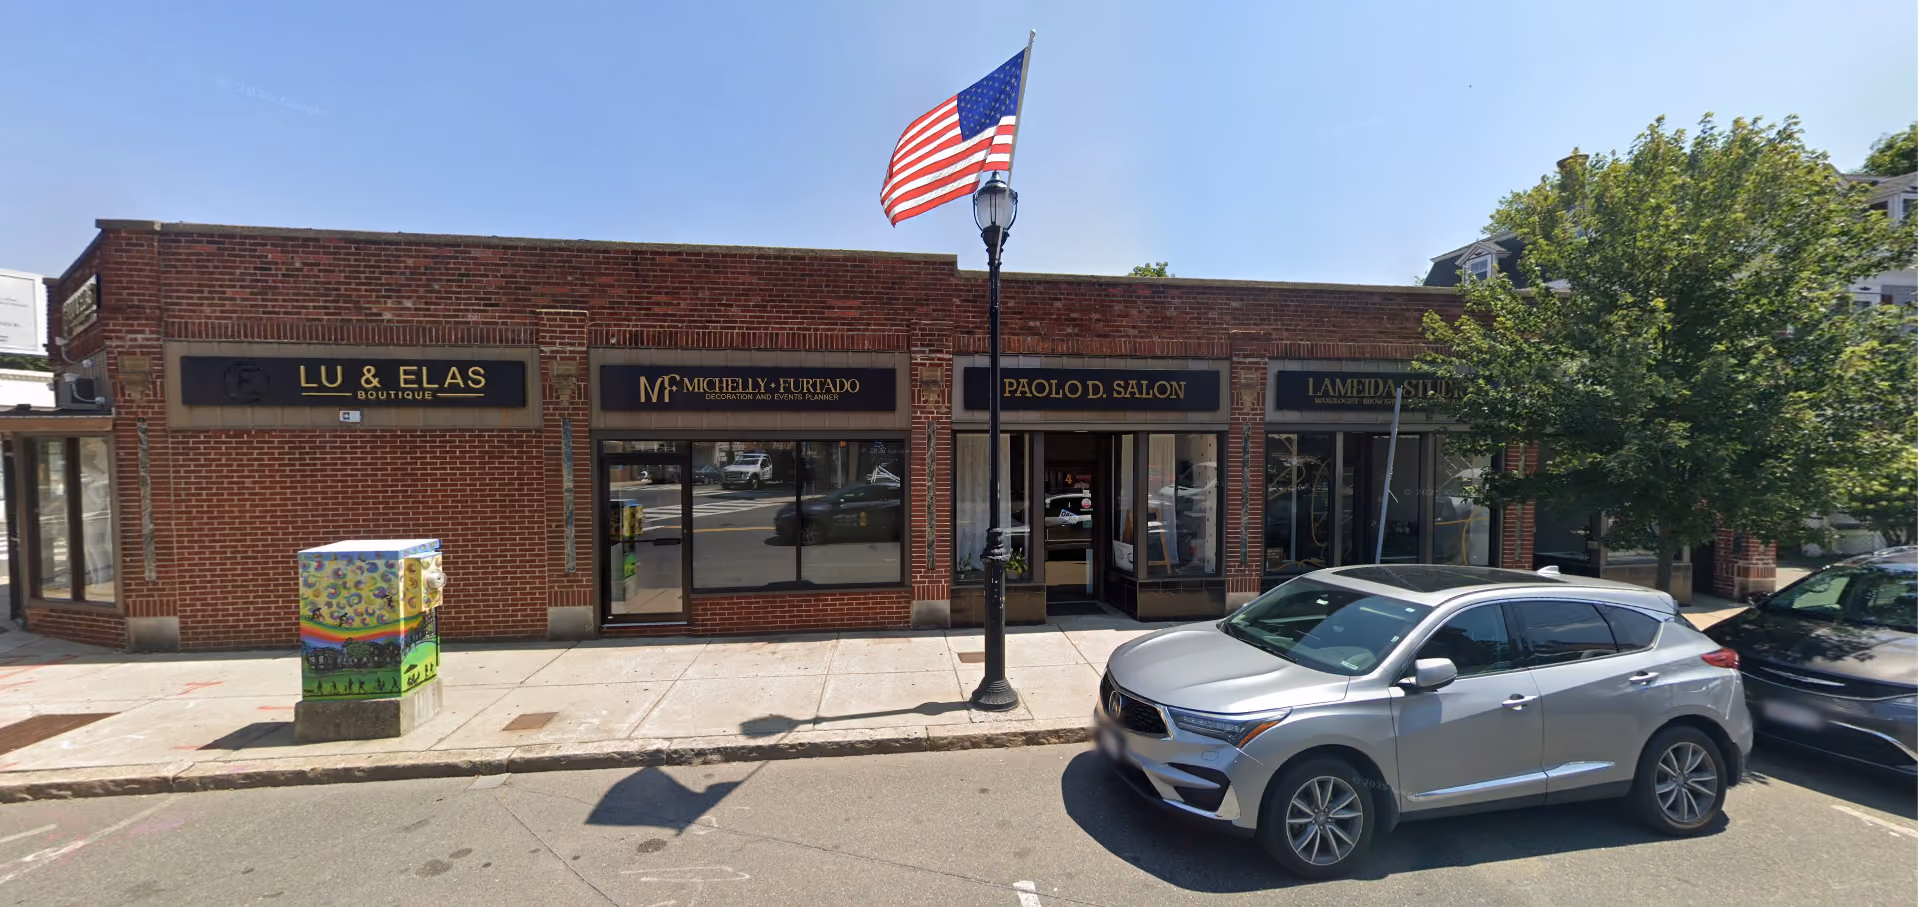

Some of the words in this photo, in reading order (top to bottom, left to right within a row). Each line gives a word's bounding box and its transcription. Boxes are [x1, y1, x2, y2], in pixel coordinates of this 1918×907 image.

[300, 365, 343, 388] LU
[360, 365, 381, 388] &
[399, 366, 486, 389] ELAS
[683, 377, 768, 392] MICHELLY
[779, 378, 860, 393] FURTADO
[357, 390, 433, 400] BOUTIQUE
[1003, 378, 1082, 399] PAOLO
[1087, 380, 1107, 399] D.
[1113, 380, 1187, 400] SALON
[1307, 377, 1396, 397] LAMEIDA
[774, 393, 803, 401] EVENTS
[1064, 473, 1073, 485] 4
